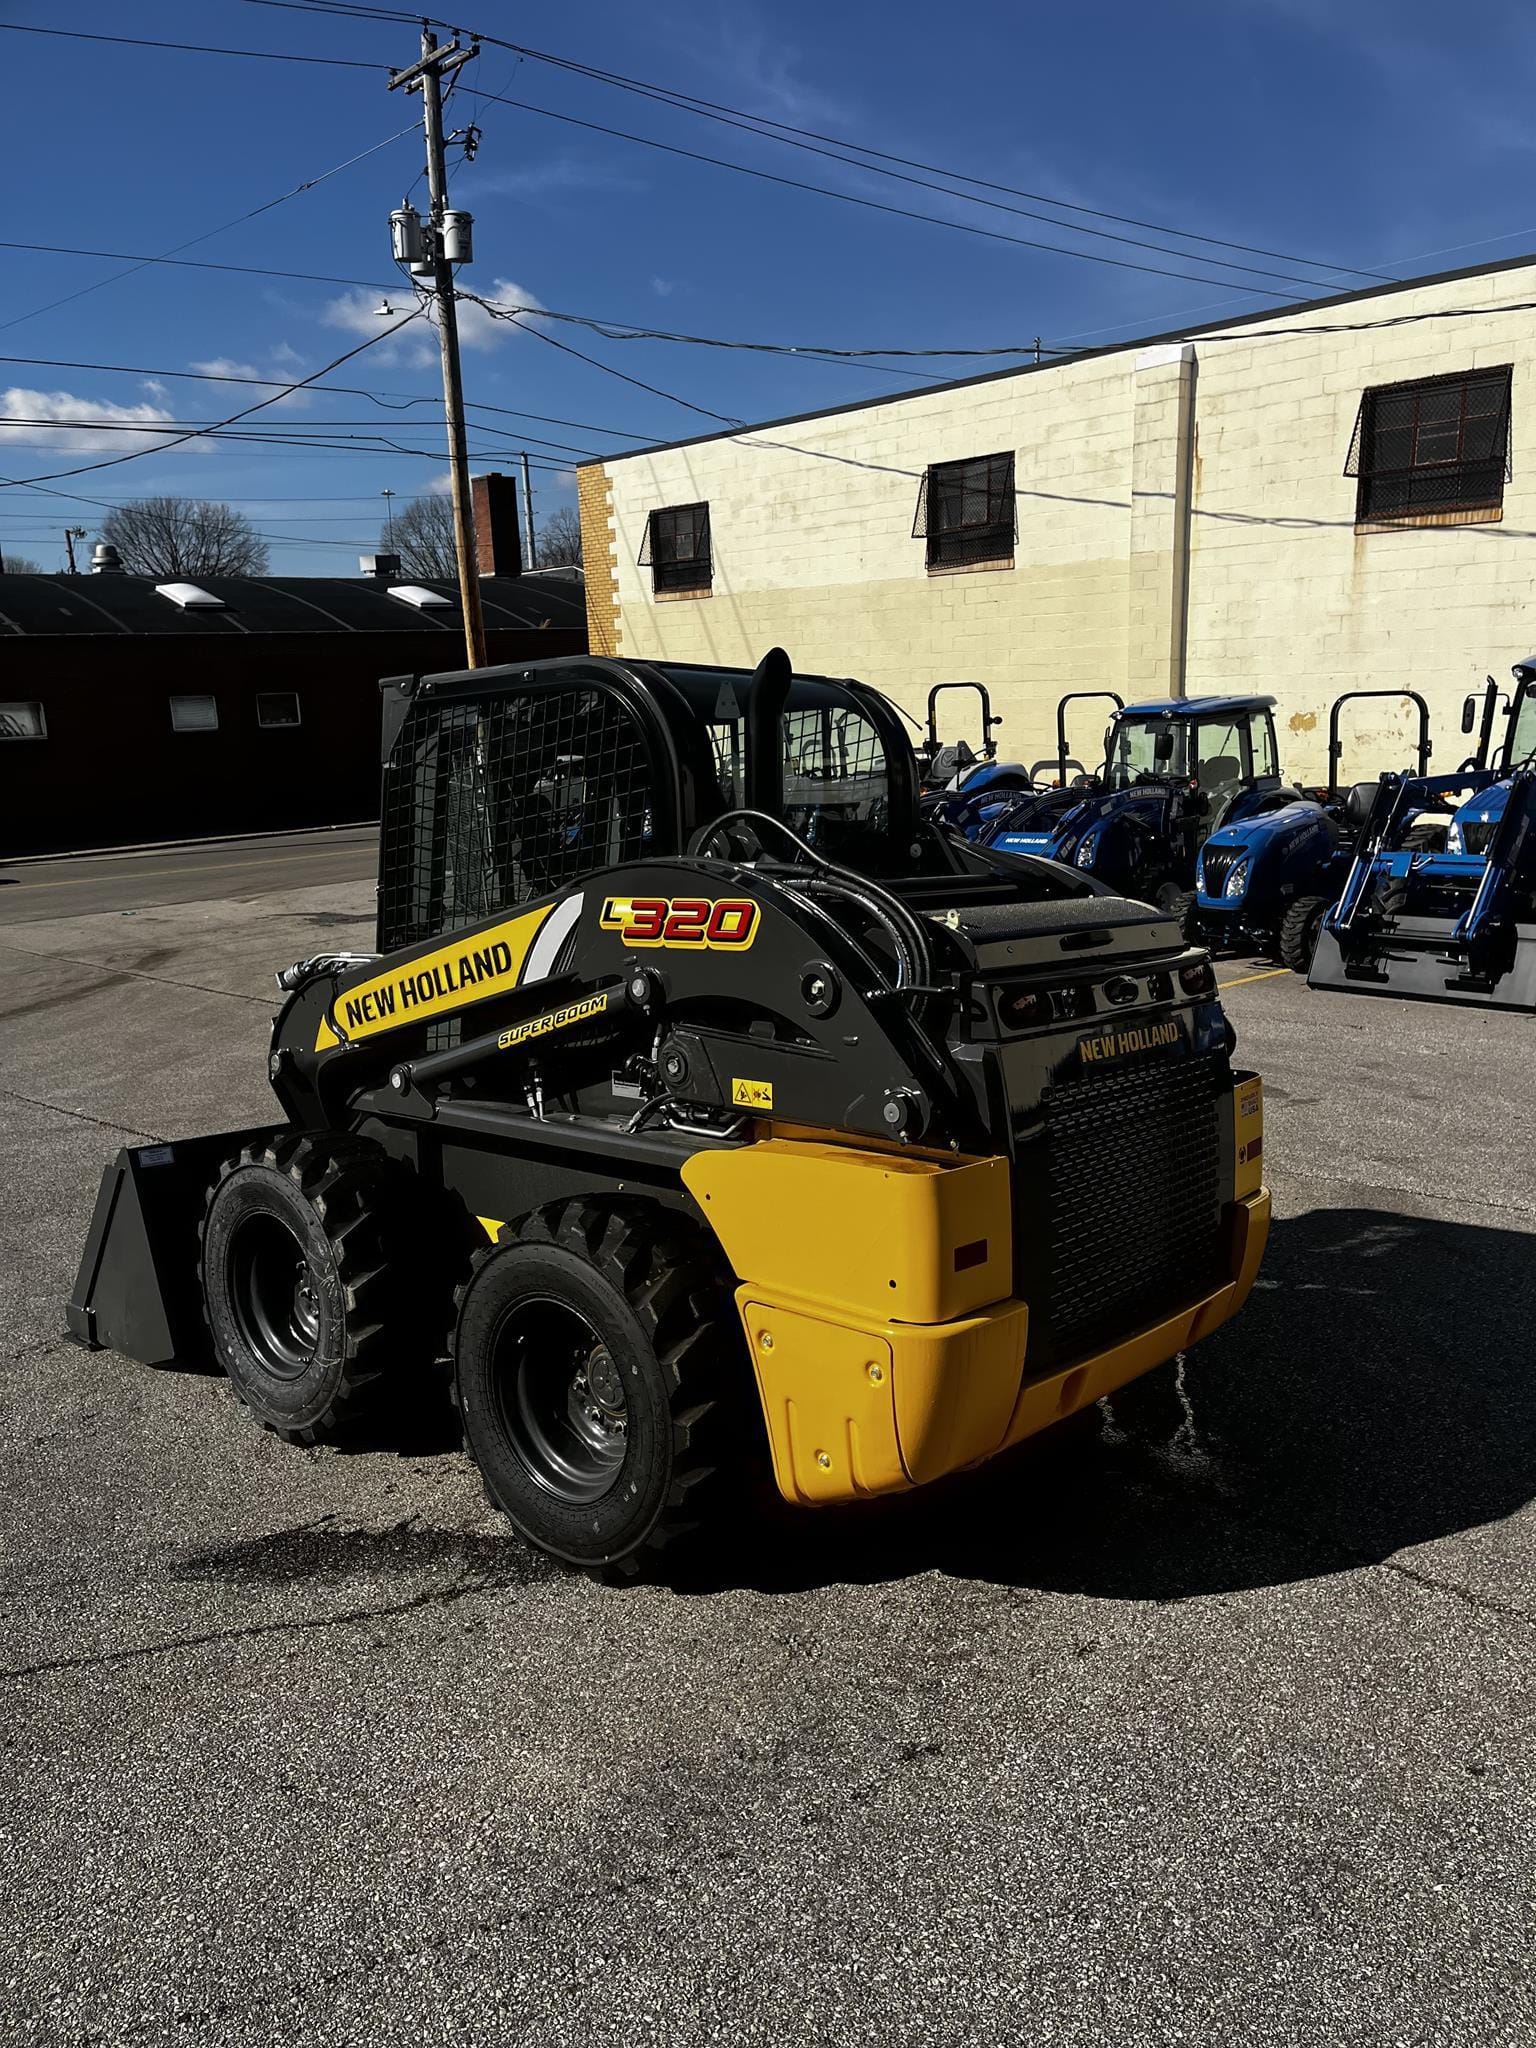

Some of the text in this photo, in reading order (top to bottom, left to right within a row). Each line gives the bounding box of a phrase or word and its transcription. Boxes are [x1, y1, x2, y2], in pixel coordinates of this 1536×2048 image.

[600, 897, 760, 950] L320
[345, 941, 512, 1029] NEW HOLLAND
[499, 994, 608, 1049] SUPER BOOM
[1080, 1022, 1179, 1062] NEW HOLLAND
